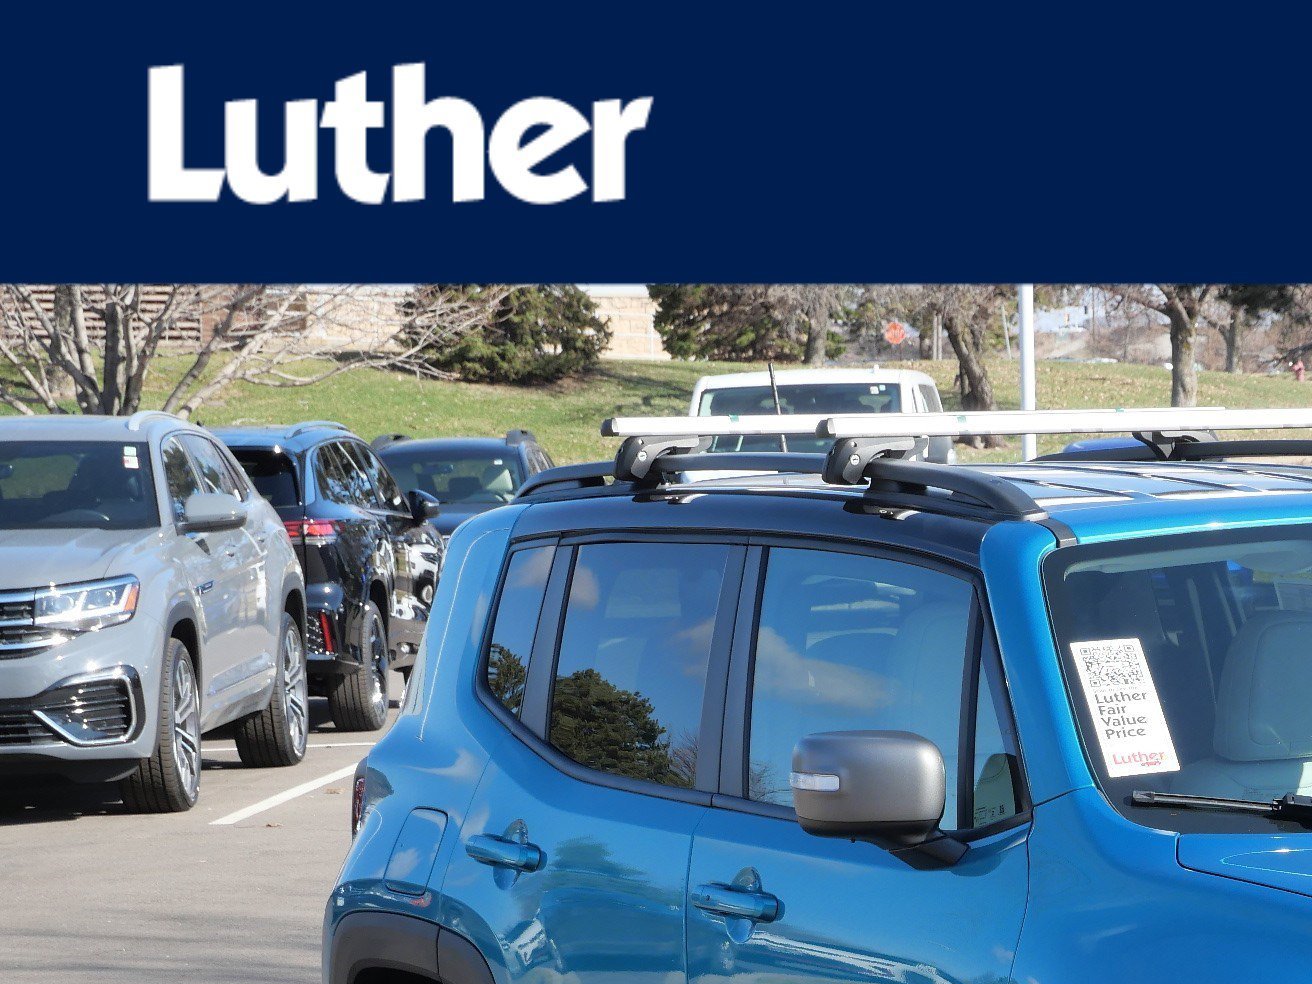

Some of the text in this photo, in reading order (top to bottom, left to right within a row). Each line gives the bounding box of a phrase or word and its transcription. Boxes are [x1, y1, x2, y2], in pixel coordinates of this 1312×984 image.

[1094, 691, 1148, 705] Luther
[1098, 704, 1127, 716] Fair
[1101, 715, 1148, 727] Value
[1105, 727, 1147, 739] Price
[1112, 750, 1166, 765] Luther
